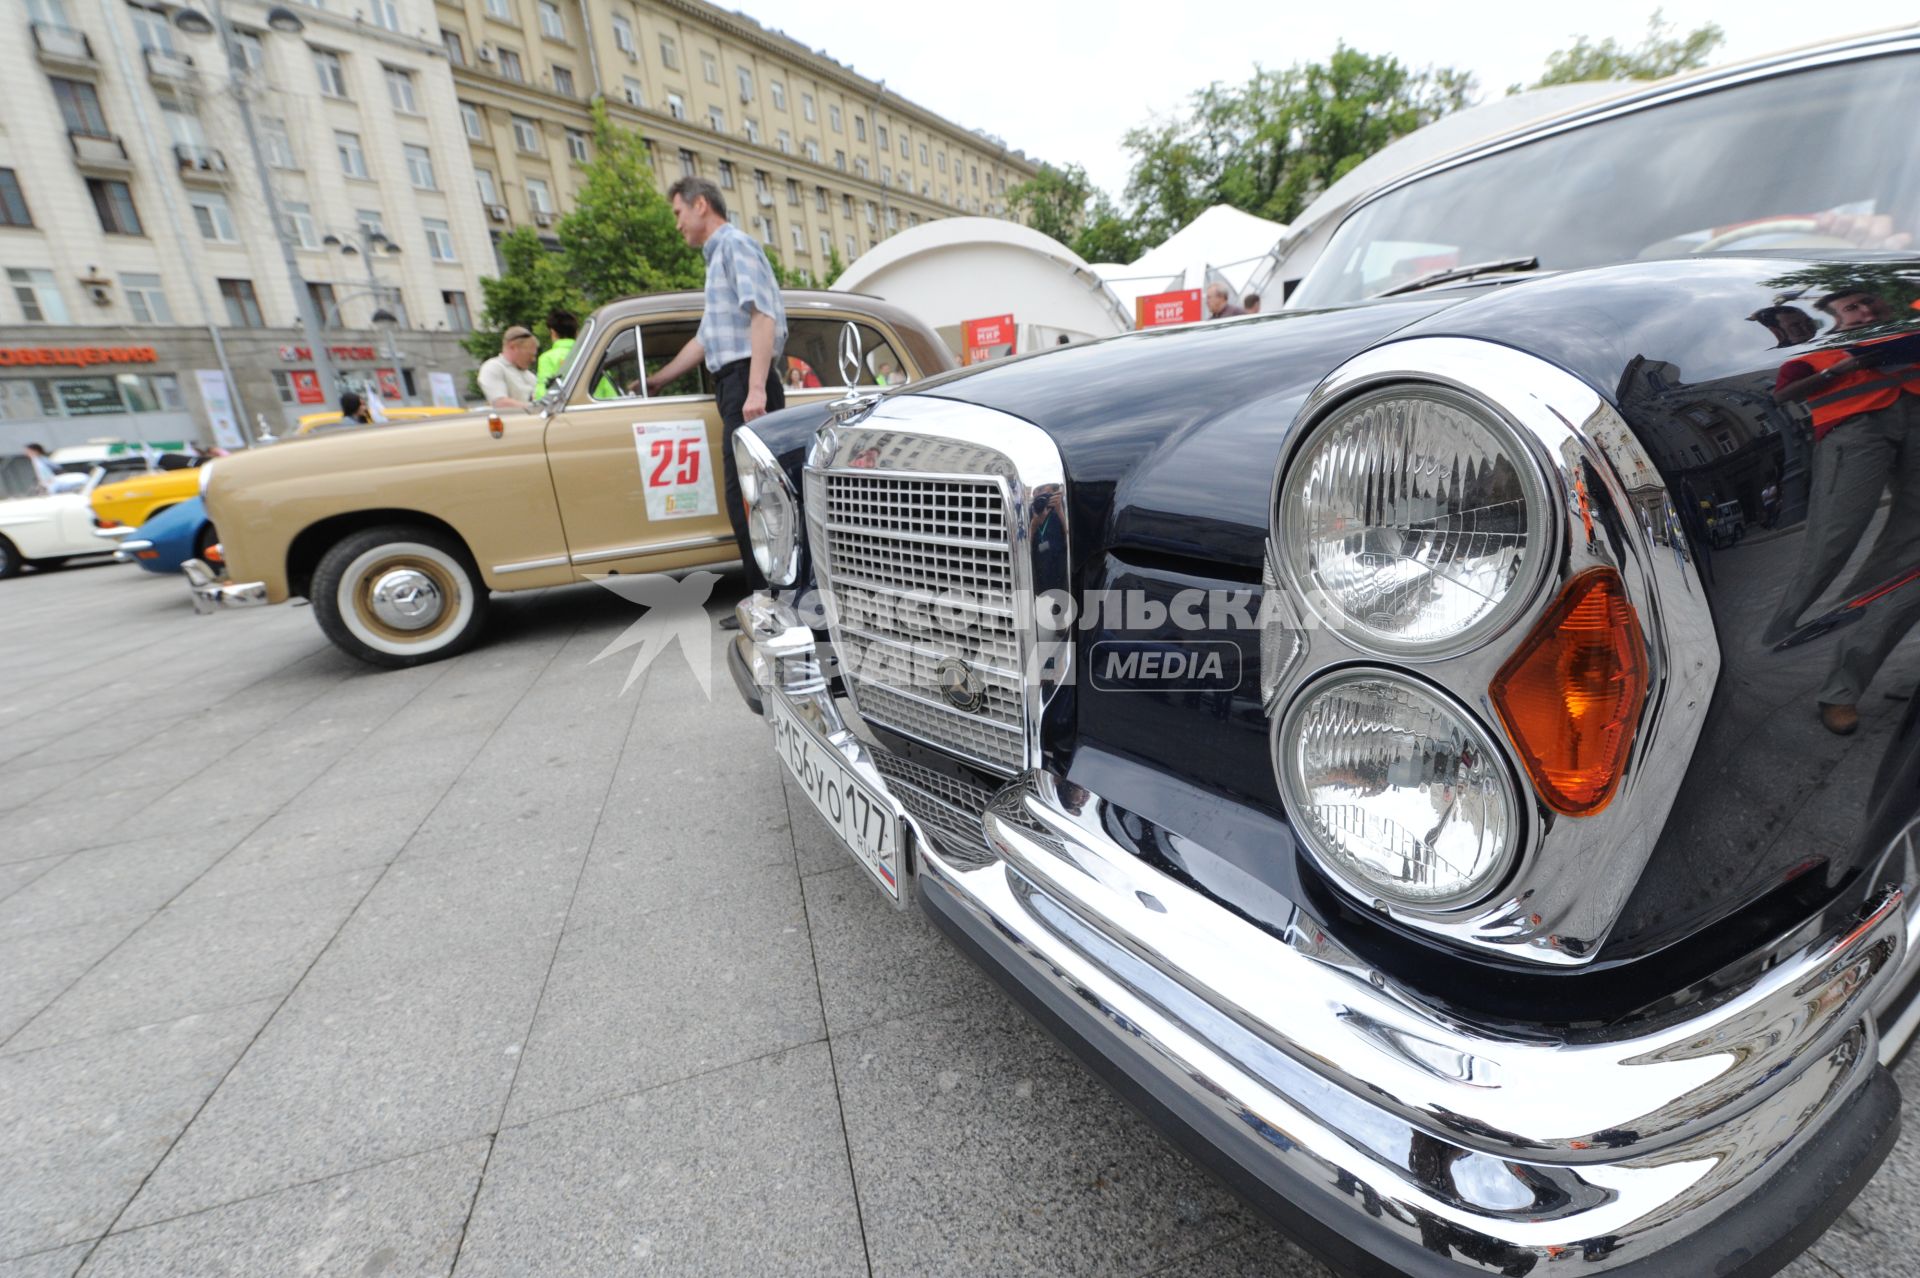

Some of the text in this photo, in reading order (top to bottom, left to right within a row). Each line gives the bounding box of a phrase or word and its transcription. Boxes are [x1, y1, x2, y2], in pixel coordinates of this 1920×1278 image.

[1155, 308, 1184, 320] МИР
[649, 437, 701, 488] 25
[846, 783, 886, 852] 177
[857, 836, 878, 866] RUS
